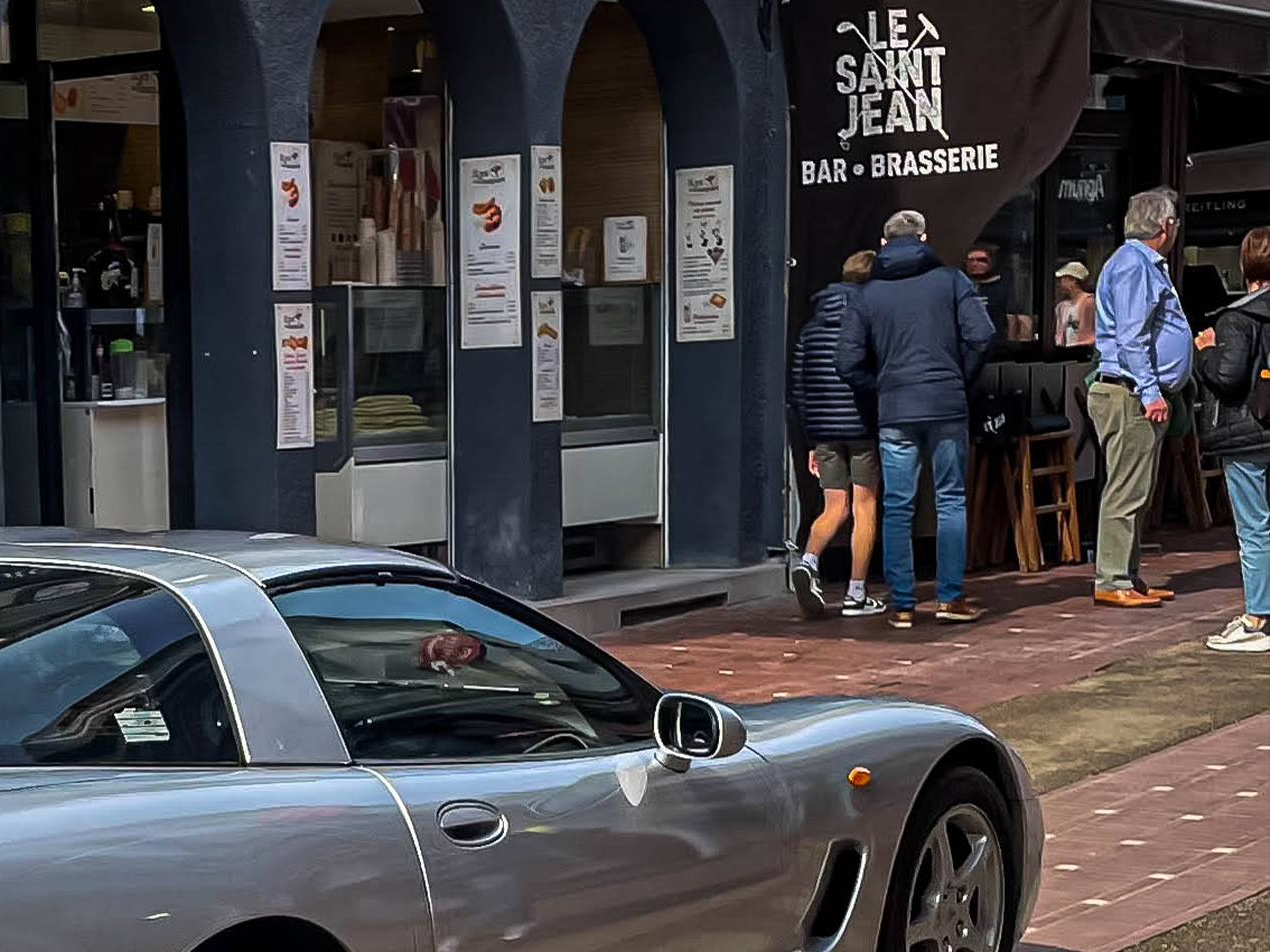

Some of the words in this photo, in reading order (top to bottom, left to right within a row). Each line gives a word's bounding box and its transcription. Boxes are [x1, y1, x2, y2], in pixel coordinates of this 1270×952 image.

[867, 8, 910, 50] LE
[835, 46, 946, 95] SAINT
[836, 87, 944, 141] JEAN
[801, 157, 848, 186] BAR
[870, 143, 999, 179] BRASSERIE
